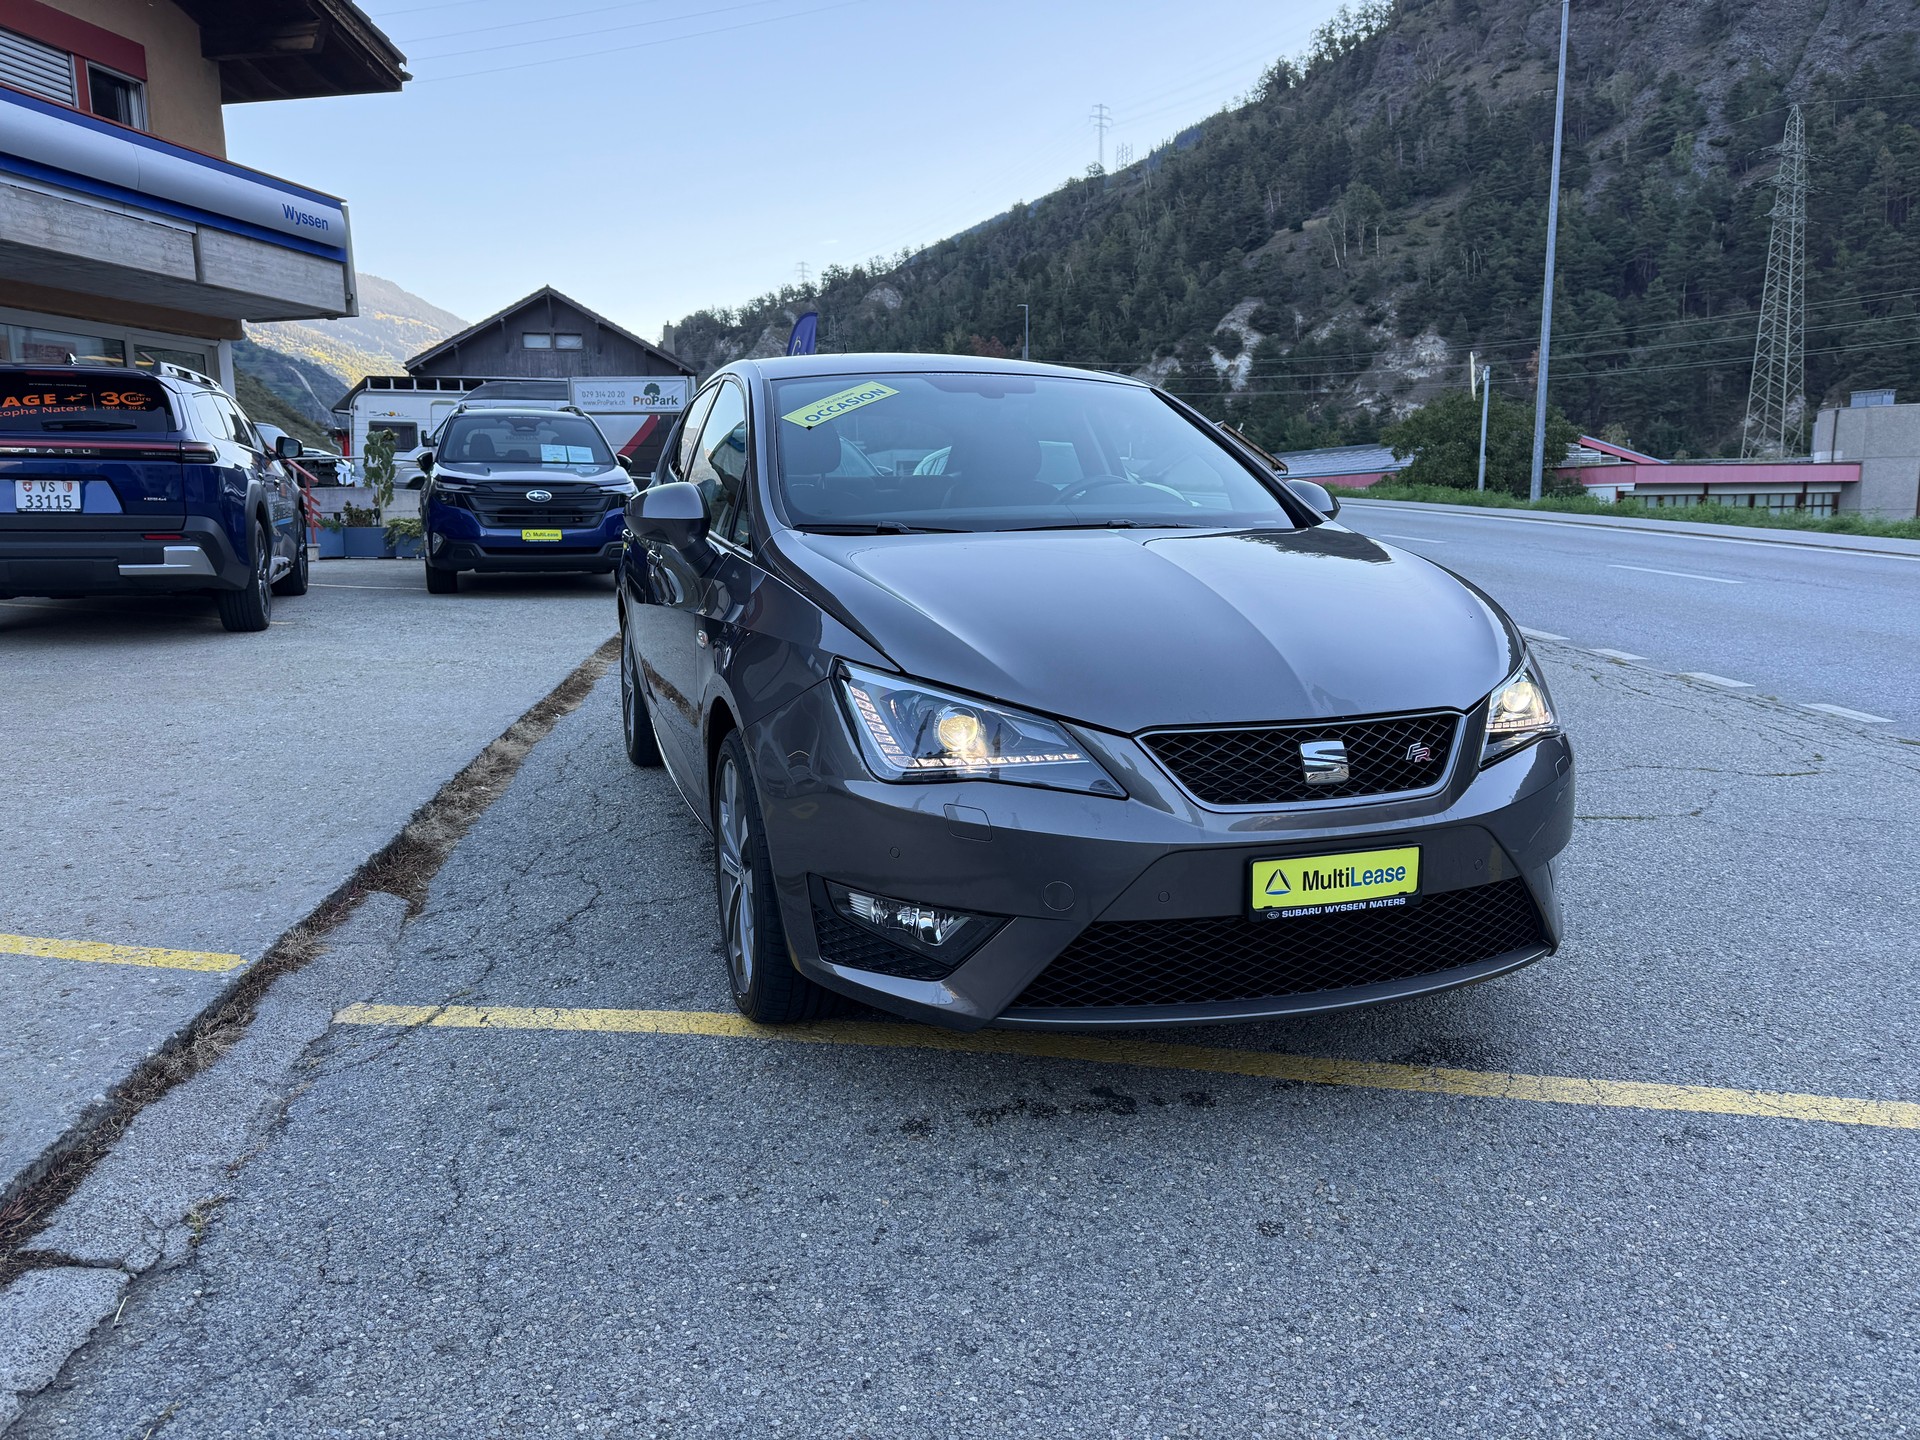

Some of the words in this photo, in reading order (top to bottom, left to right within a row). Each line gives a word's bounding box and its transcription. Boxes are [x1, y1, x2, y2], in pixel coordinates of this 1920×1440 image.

[282, 203, 329, 231] Wyssen
[2, 394, 57, 408] AGE
[632, 395, 679, 406] ProPark
[804, 388, 887, 422] OCCASION
[42, 405, 87, 414] Naters
[40, 481, 56, 493] VS
[25, 494, 73, 509] 33115
[1302, 865, 1406, 892] MultiLease
[1281, 906, 1322, 918] SUBARU
[1324, 901, 1367, 914] WYSSEN
[1369, 897, 1406, 909] NATERS
